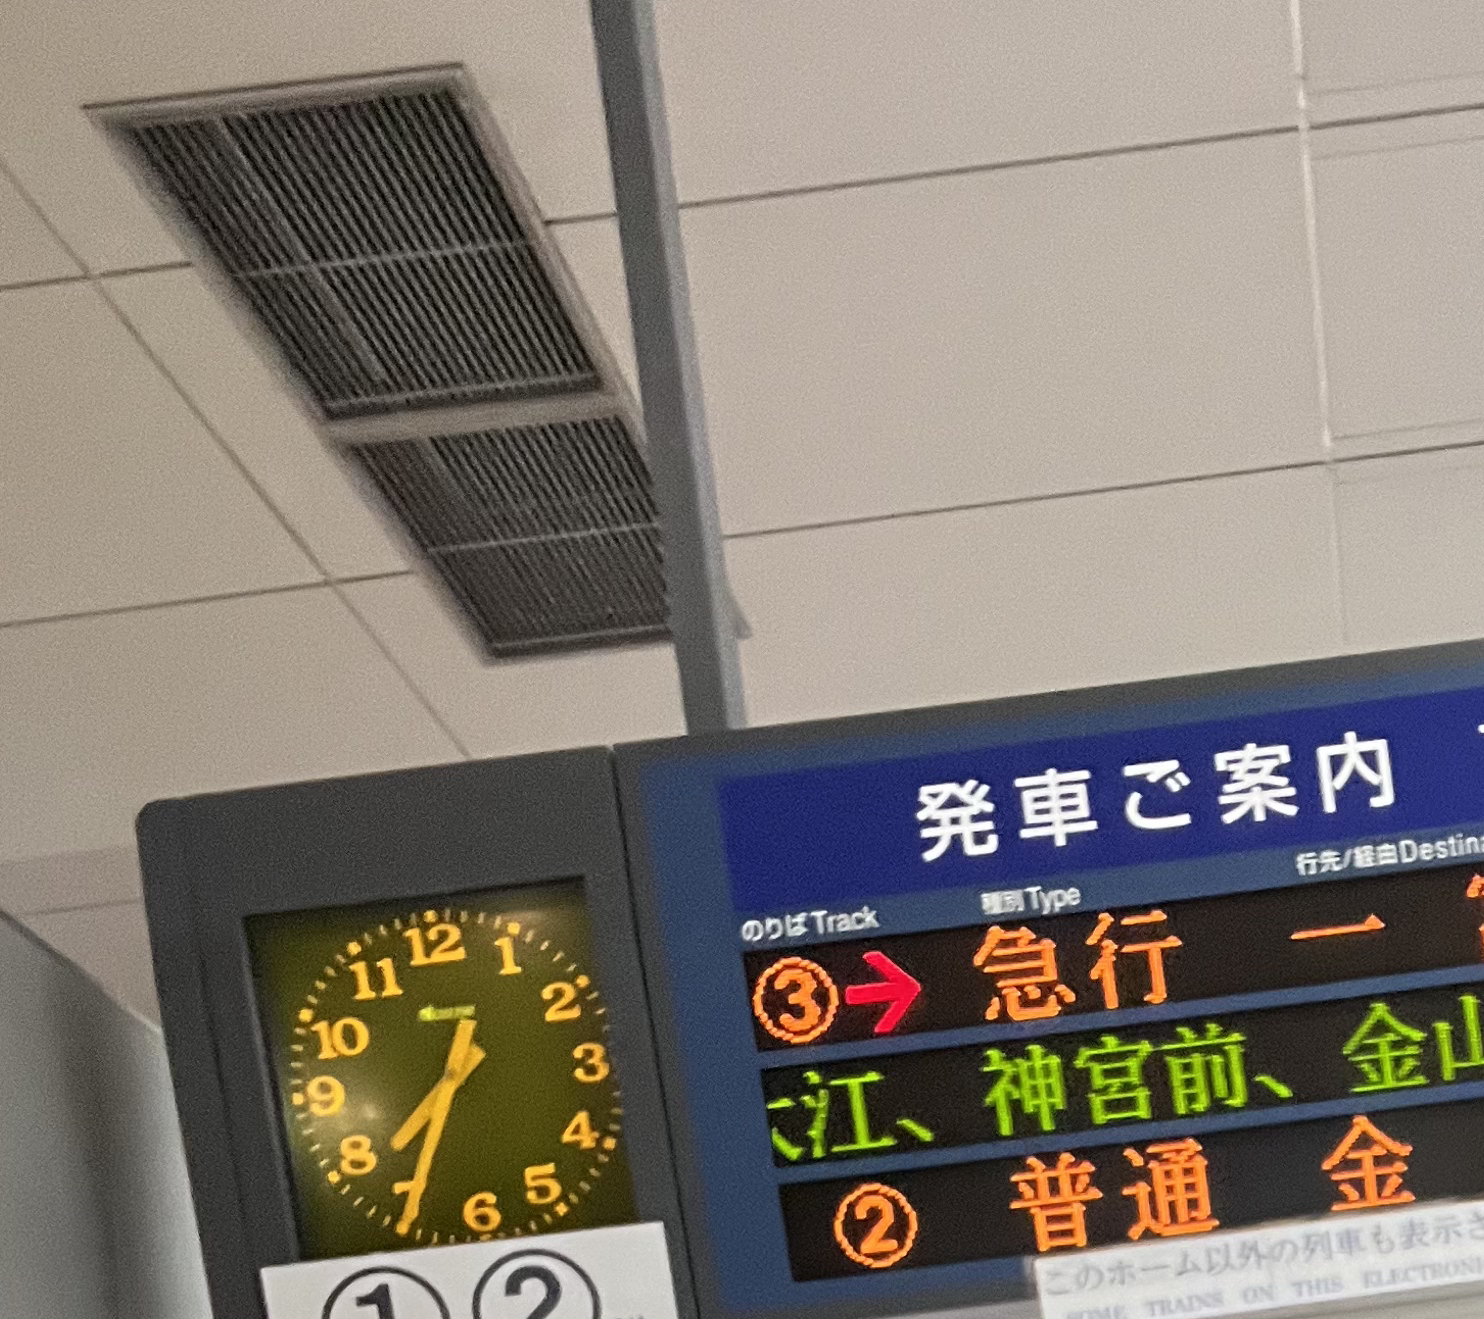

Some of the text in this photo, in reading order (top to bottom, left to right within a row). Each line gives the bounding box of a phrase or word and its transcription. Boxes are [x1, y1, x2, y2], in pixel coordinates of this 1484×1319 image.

[915, 730, 1395, 863] 発車ご案内
[405, 922, 466, 966] 12
[493, 935, 523, 976] 1
[348, 957, 403, 1000] 11
[972, 909, 1183, 1023] 急行
[541, 980, 583, 1022] 2
[310, 1015, 371, 1060] 10
[572, 1041, 611, 1083] 3
[306, 1074, 346, 1117] 9
[560, 1110, 599, 1151] 4
[338, 1133, 378, 1176] 8
[522, 1162, 564, 1206] 5
[1008, 1136, 1220, 1253] 普通
[461, 1191, 502, 1233] 6
[1147, 1291, 1225, 1319] TRAINS
[1241, 1284, 1275, 1304] ON
[1295, 1274, 1345, 1300] THIS
